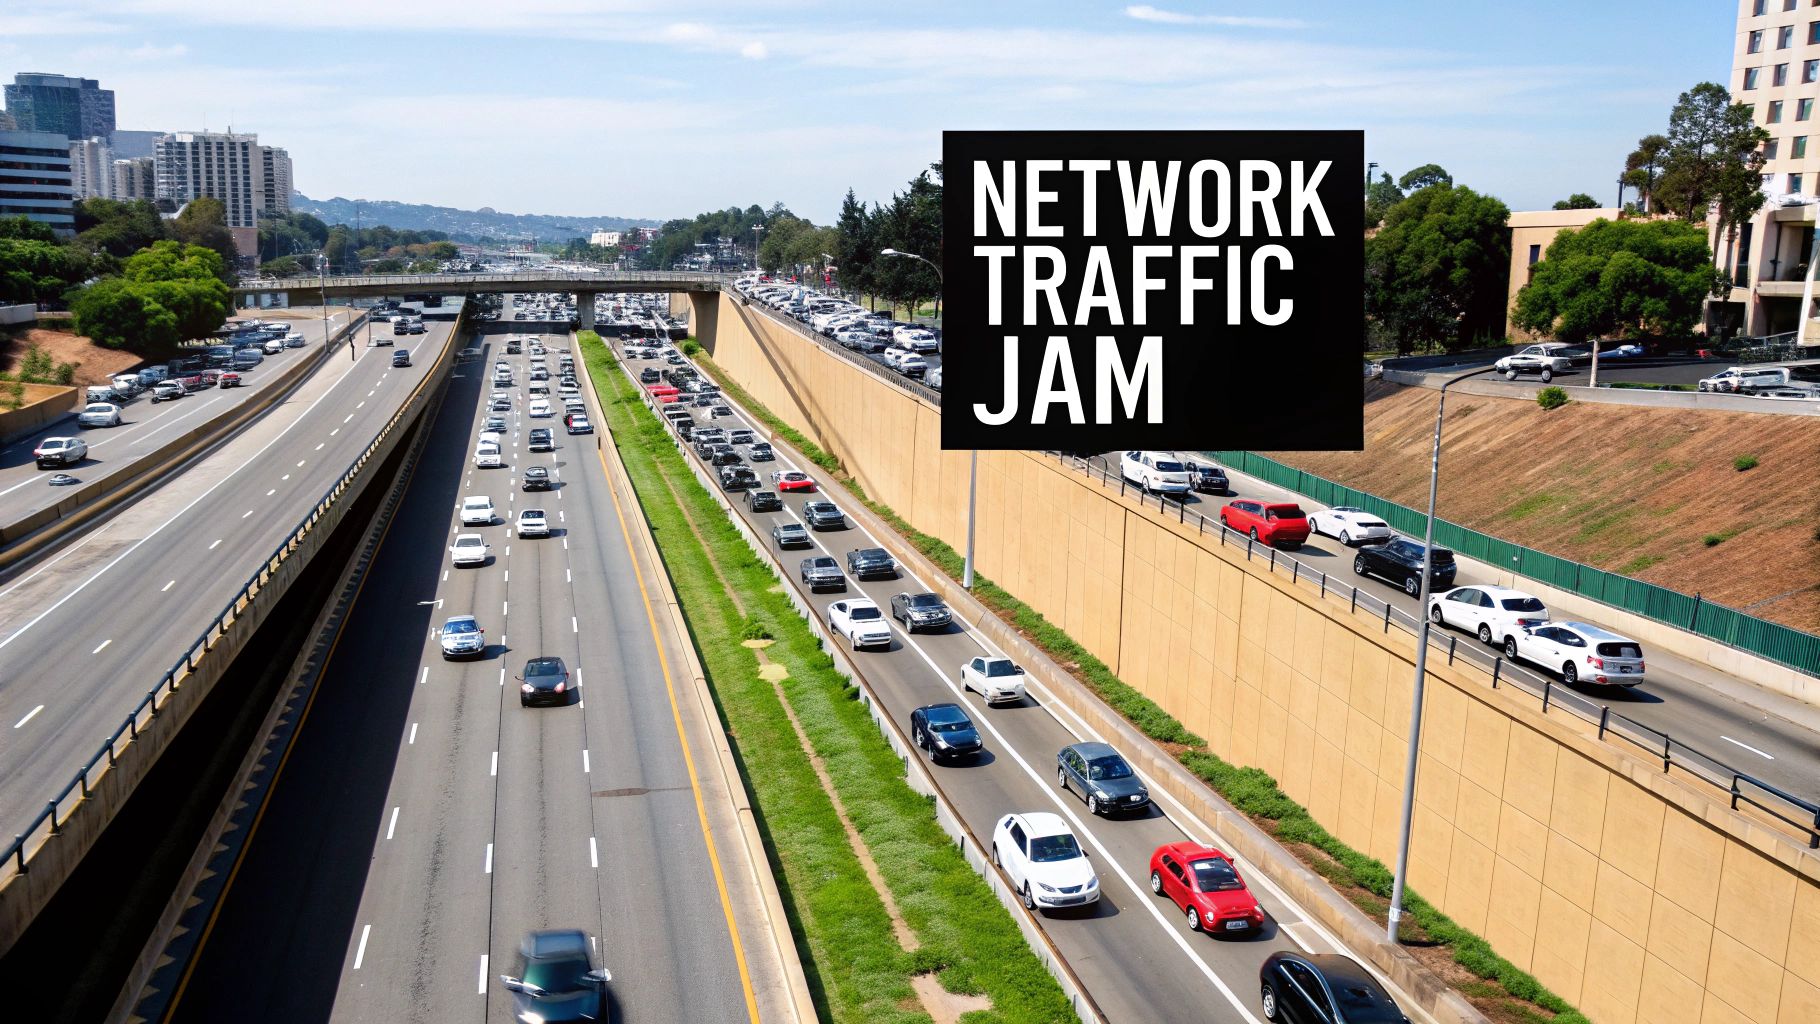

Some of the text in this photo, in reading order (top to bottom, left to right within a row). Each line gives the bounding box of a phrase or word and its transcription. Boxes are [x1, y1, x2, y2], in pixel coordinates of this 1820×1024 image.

[973, 159, 1336, 238] NETWORK
[973, 244, 1294, 326] TRAFFIC
[972, 335, 1163, 426] JAM
